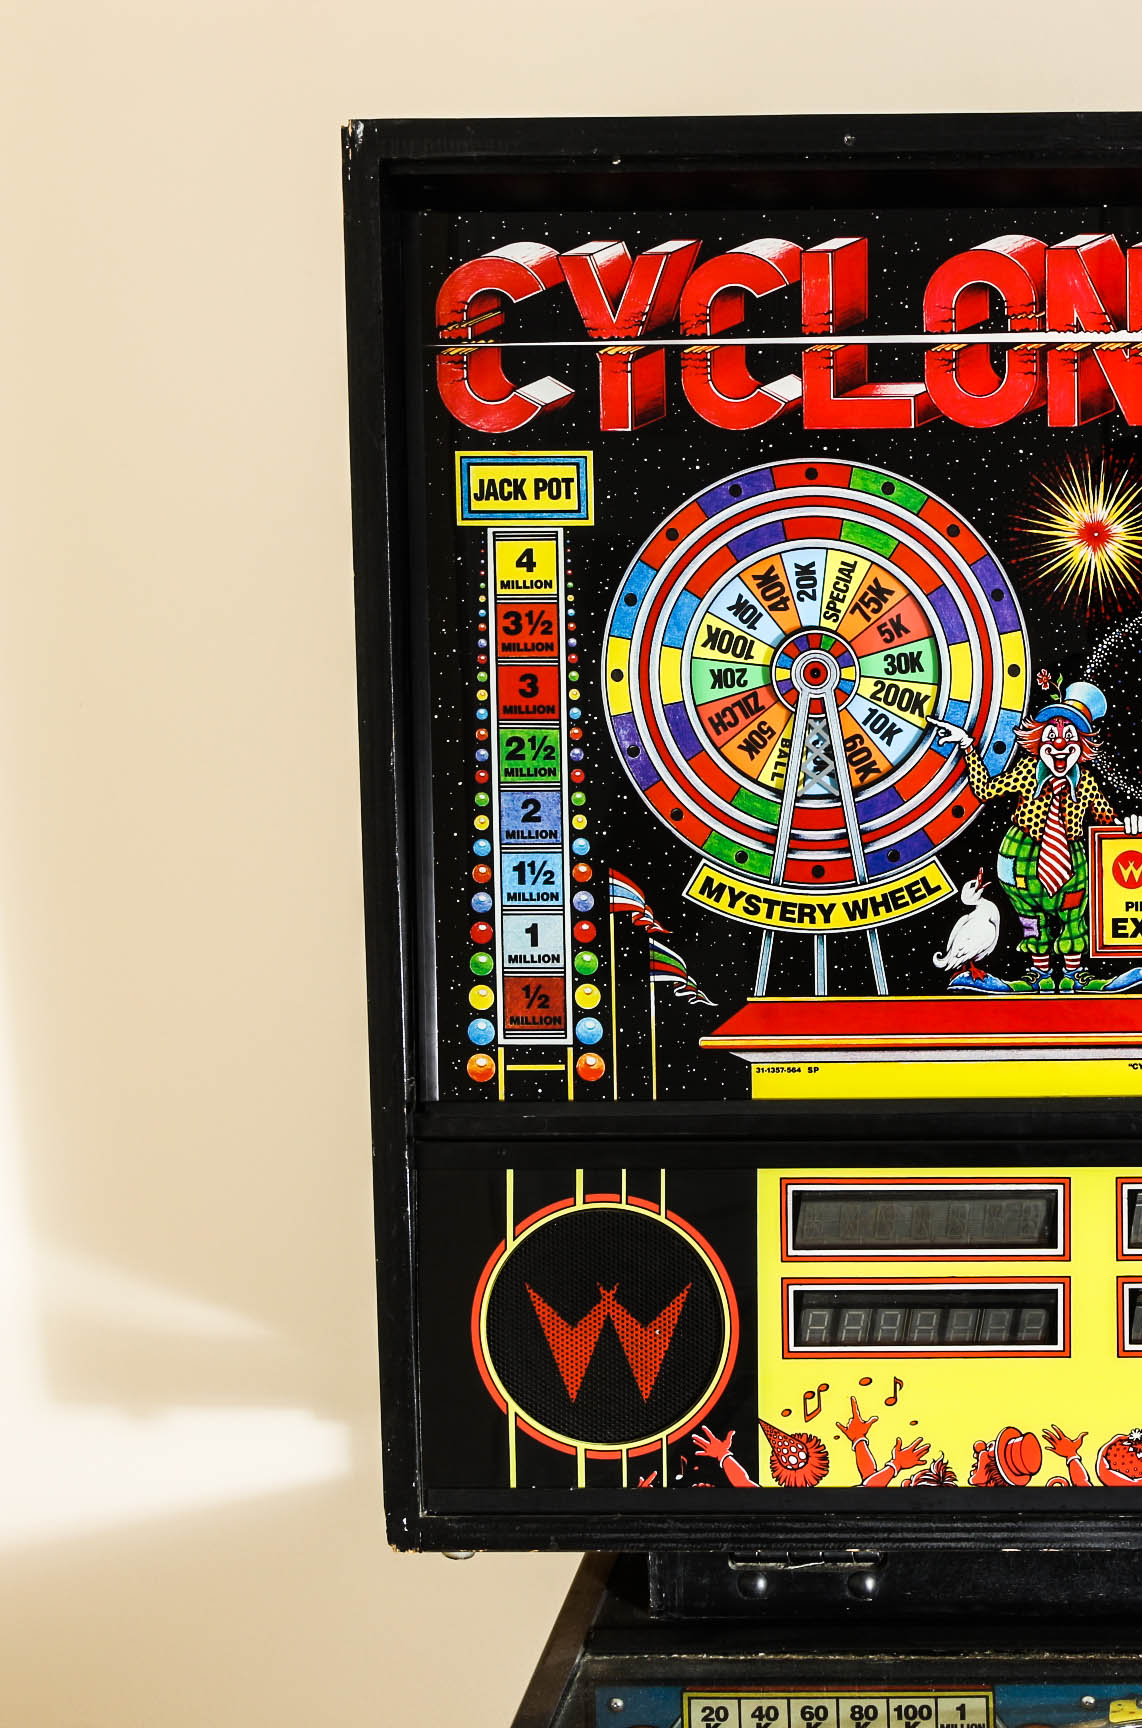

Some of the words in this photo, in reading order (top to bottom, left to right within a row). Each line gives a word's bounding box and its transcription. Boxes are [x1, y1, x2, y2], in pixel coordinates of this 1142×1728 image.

[473, 477, 527, 501] JACK
[533, 477, 574, 500] POT
[515, 548, 536, 573] 4
[500, 579, 553, 590] MILLION
[751, 565, 790, 613] 40K
[796, 561, 817, 602] 20K
[823, 559, 858, 624] SPECIAL
[849, 577, 894, 623] 75K
[726, 594, 764, 631] 10K
[878, 613, 911, 644] 5K
[501, 643, 554, 653] MILLION
[700, 624, 755, 661] 100K
[883, 651, 924, 675] 30K
[518, 673, 539, 699] 3
[710, 667, 748, 690] 20K
[503, 704, 556, 715] MILLION
[869, 679, 931, 720] 200K
[710, 691, 766, 736] ZILCH
[861, 707, 904, 747] 10K
[737, 720, 777, 761] 50K
[770, 737, 792, 782] BALL
[843, 733, 882, 784] 60K
[504, 766, 557, 778] MILLION
[521, 798, 541, 823] 2
[505, 829, 558, 840] MILLION
[507, 892, 560, 902] MILLION
[698, 875, 837, 925] MYSTERY
[841, 875, 943, 923] WHEEL
[525, 923, 540, 947] 1
[508, 954, 560, 964] MILLION
[509, 1015, 562, 1026] MILLION
[701, 1706, 729, 1722] 20
[751, 1706, 779, 1722] 40
[800, 1706, 829, 1722] 60
[850, 1706, 878, 1722] 80
[894, 1705, 932, 1721] 100
[955, 1704, 967, 1721] 1
